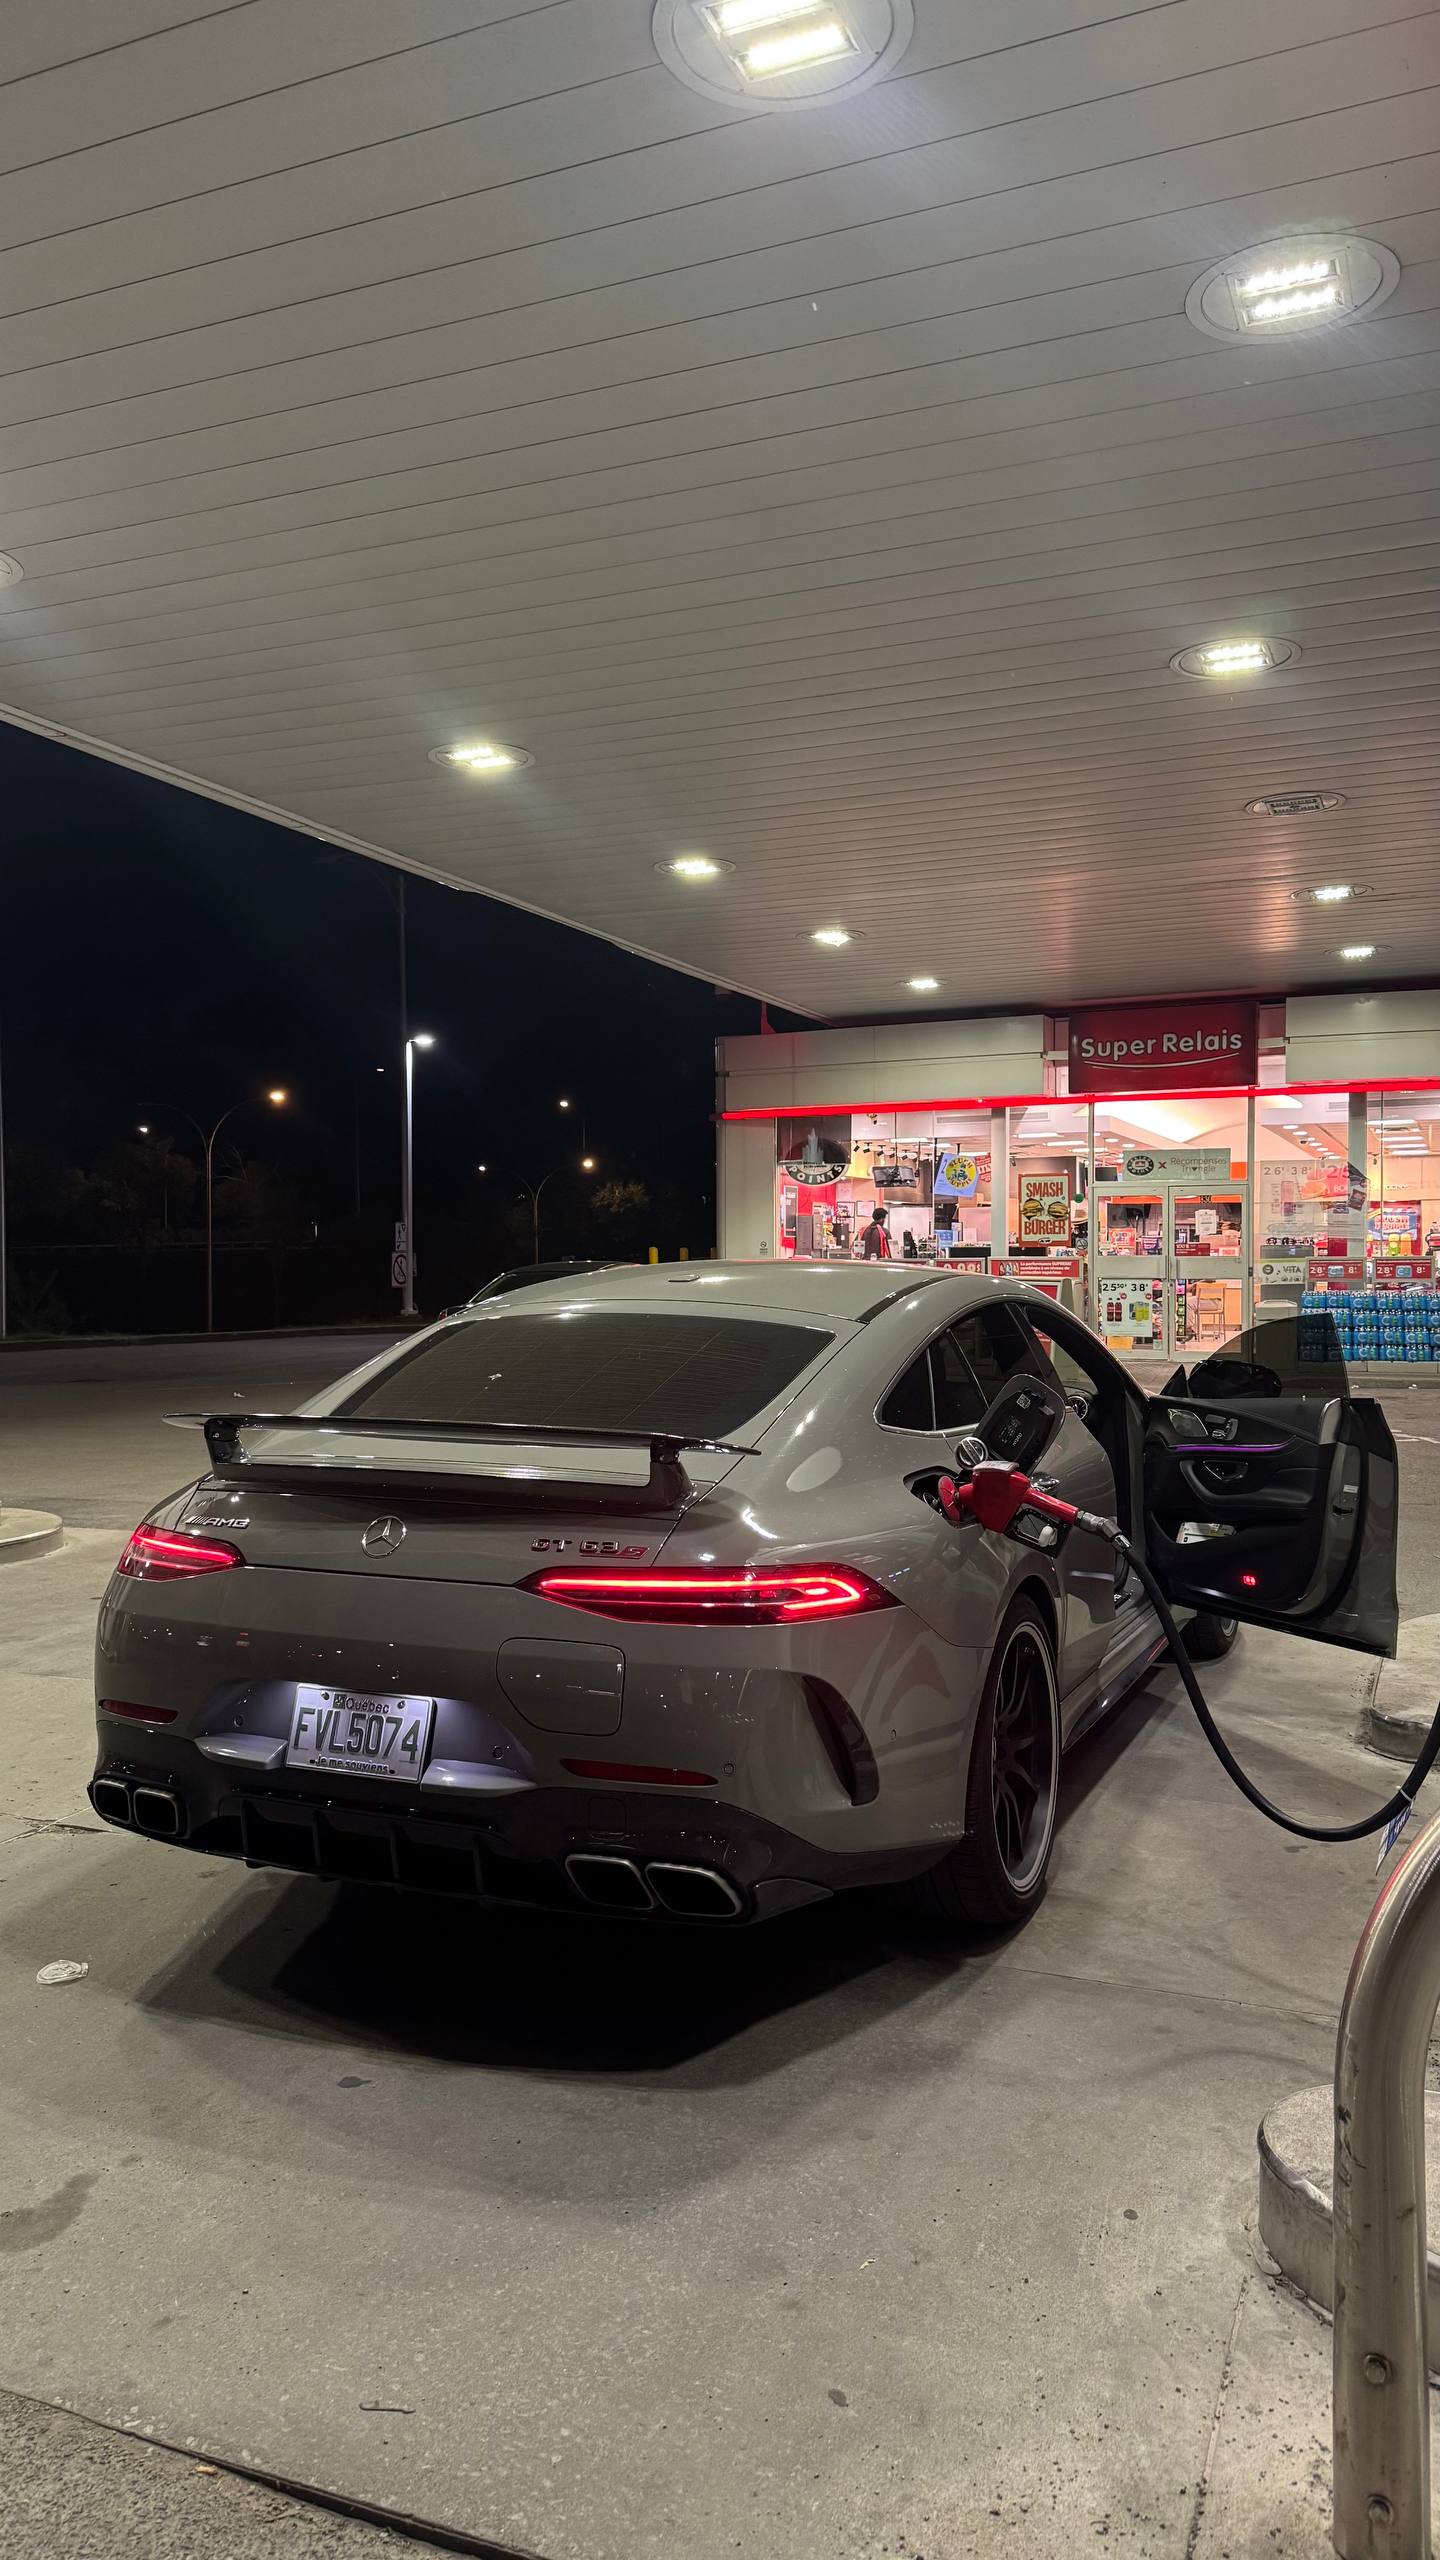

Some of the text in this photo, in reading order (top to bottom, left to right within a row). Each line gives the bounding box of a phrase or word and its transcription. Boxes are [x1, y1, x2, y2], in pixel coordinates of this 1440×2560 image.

[1081, 1029, 1242, 1061] Super Relais
[788, 1164, 843, 1184] POINTS
[1026, 1181, 1064, 1198] SMASH
[1024, 1219, 1066, 1235] BURGER
[203, 1517, 251, 1530] AMG
[531, 1539, 573, 1553] GT
[345, 1697, 390, 1714] Québec
[294, 1706, 422, 1763] FVL5074
[315, 1755, 389, 1775] Je me souviens
